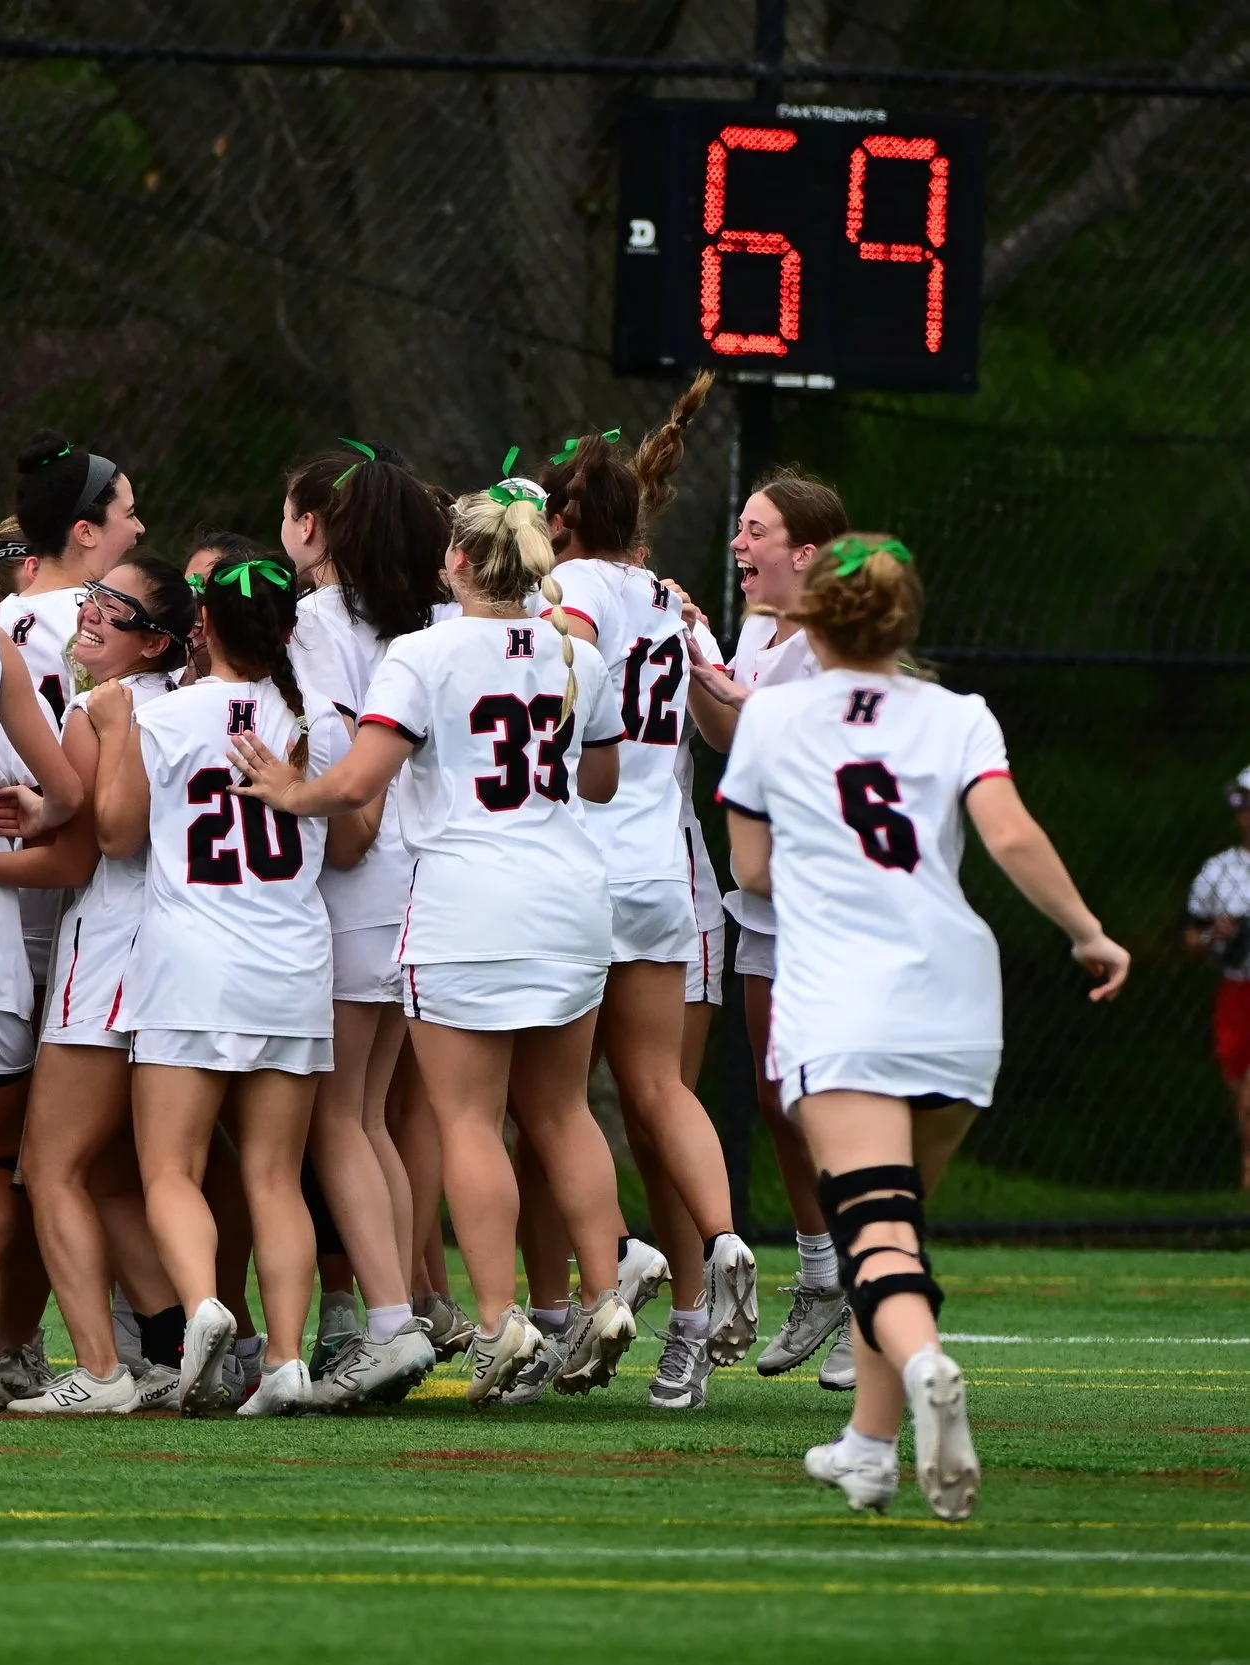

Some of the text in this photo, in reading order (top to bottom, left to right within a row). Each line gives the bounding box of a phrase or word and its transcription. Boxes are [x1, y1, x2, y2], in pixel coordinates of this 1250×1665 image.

[652, 578, 671, 611] H
[11, 613, 36, 646] H
[506, 627, 534, 659] H
[621, 634, 684, 745] 12
[843, 687, 888, 726] H
[227, 700, 257, 735] H
[469, 692, 576, 813] 33
[187, 768, 303, 885] 20
[835, 761, 921, 874] 6
